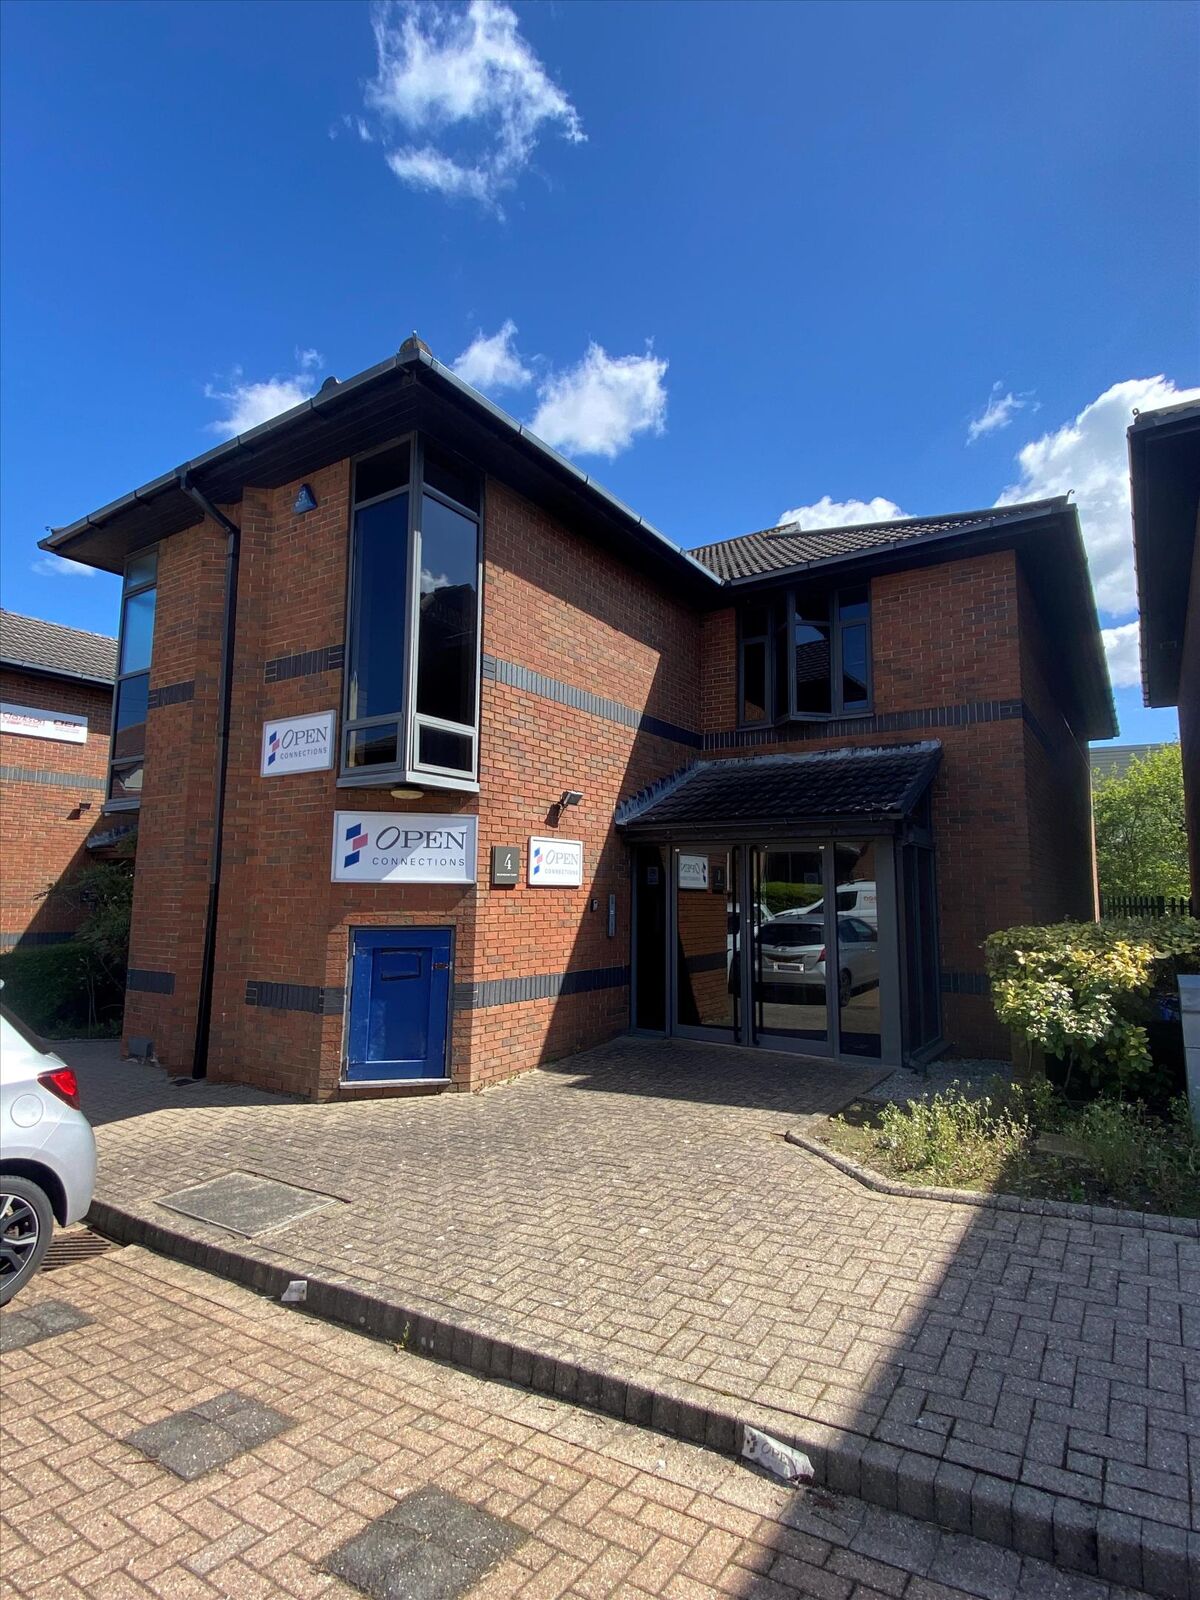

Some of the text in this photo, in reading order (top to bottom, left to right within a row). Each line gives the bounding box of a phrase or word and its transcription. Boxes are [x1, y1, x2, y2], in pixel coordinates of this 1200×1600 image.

[281, 726, 328, 749] OPEN
[280, 746, 327, 760] CONNECTIONS
[375, 826, 467, 851] OPEN
[372, 857, 465, 867] CONNECTIONS
[503, 853, 512, 870] 4
[545, 849, 579, 865] OPEN
